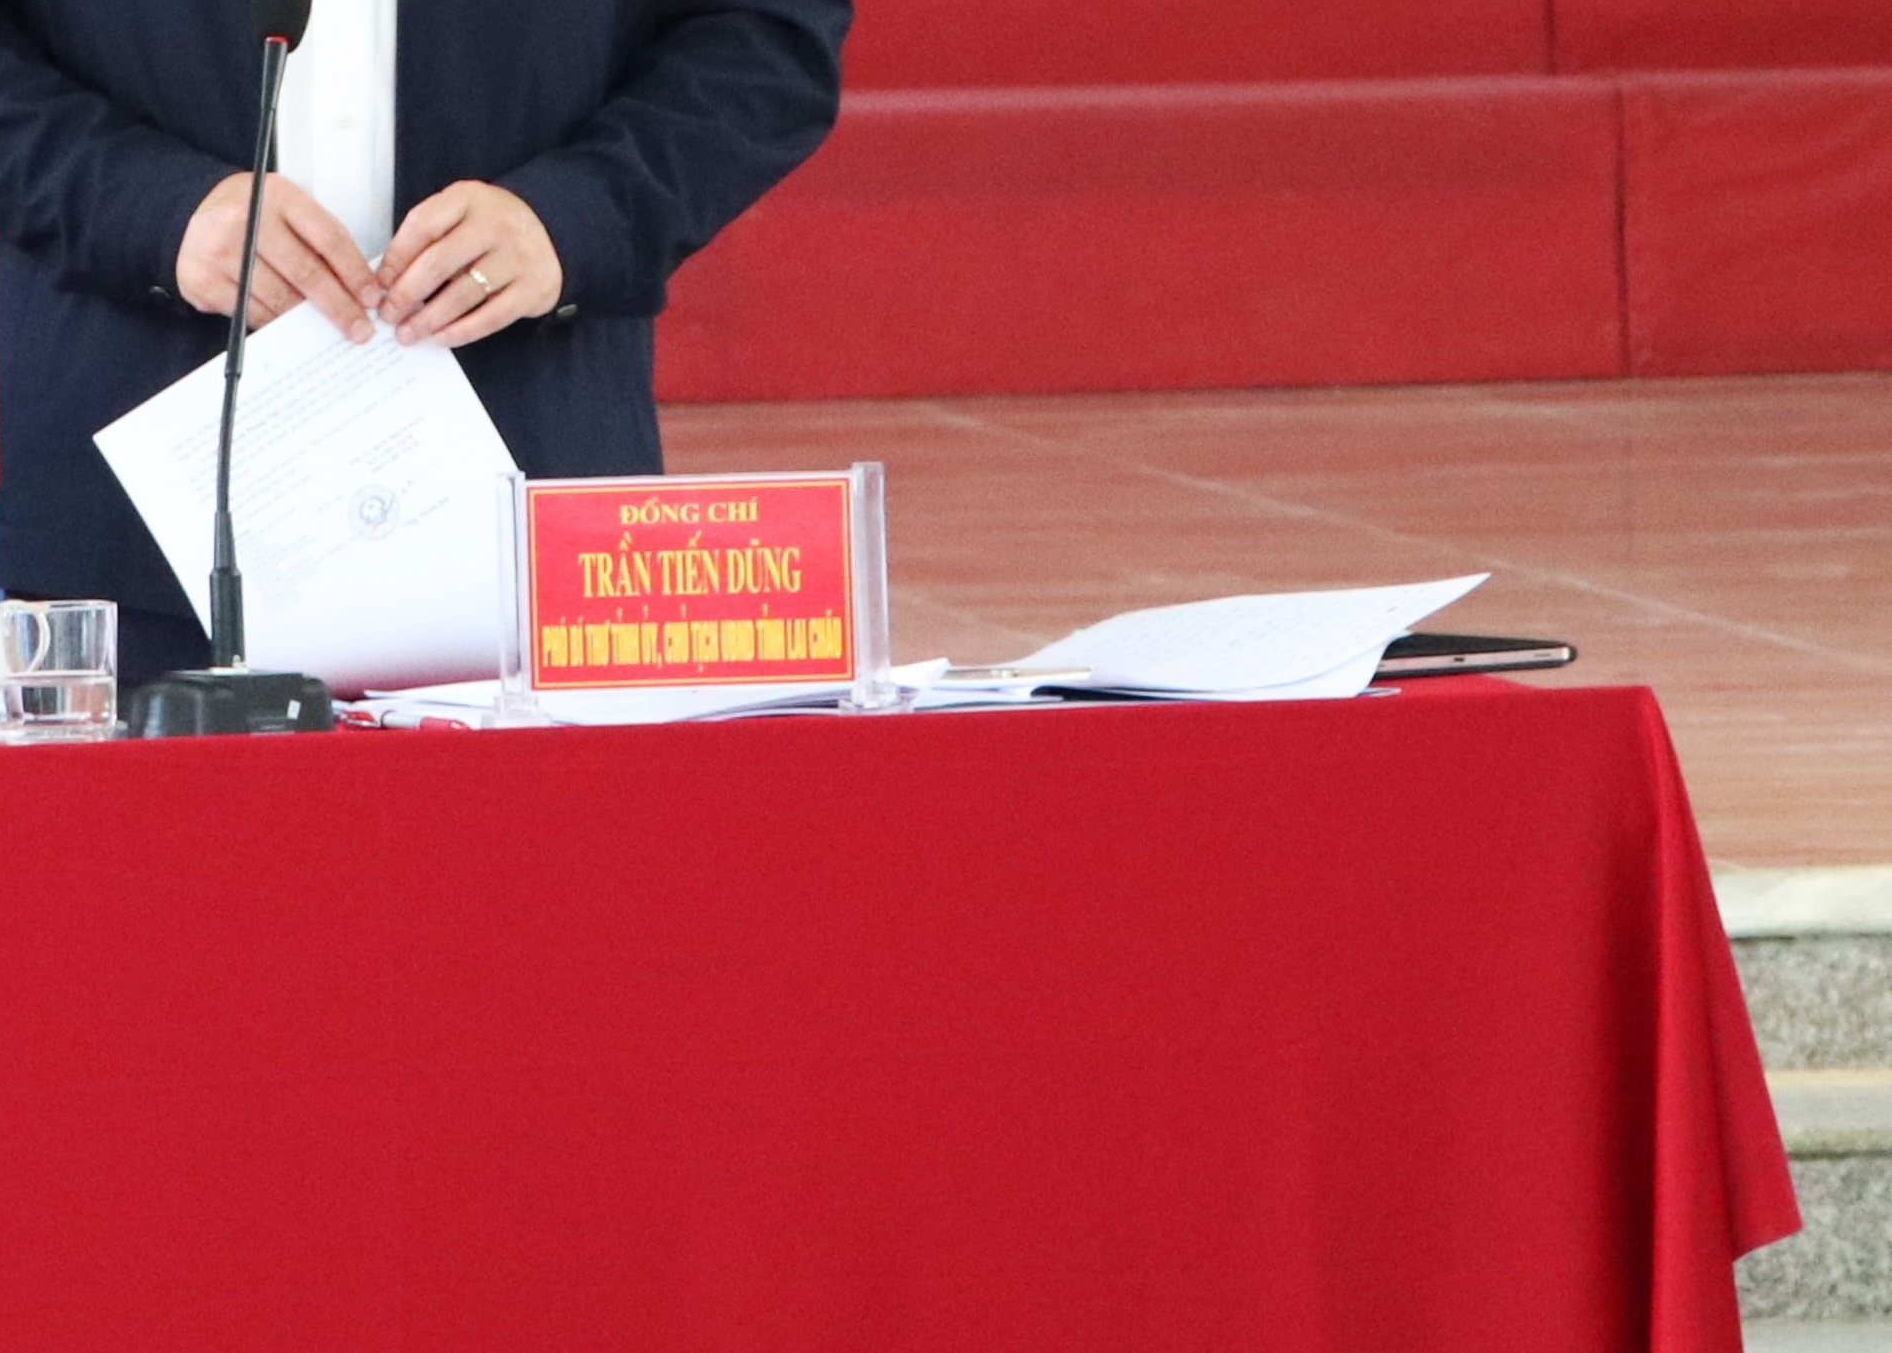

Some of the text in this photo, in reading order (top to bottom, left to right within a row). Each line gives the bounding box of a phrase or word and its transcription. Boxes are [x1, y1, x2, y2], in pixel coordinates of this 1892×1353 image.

[620, 496, 758, 525] ĐỒNG CHÍ
[579, 530, 802, 598] TRẦN TIẾN DŨNG
